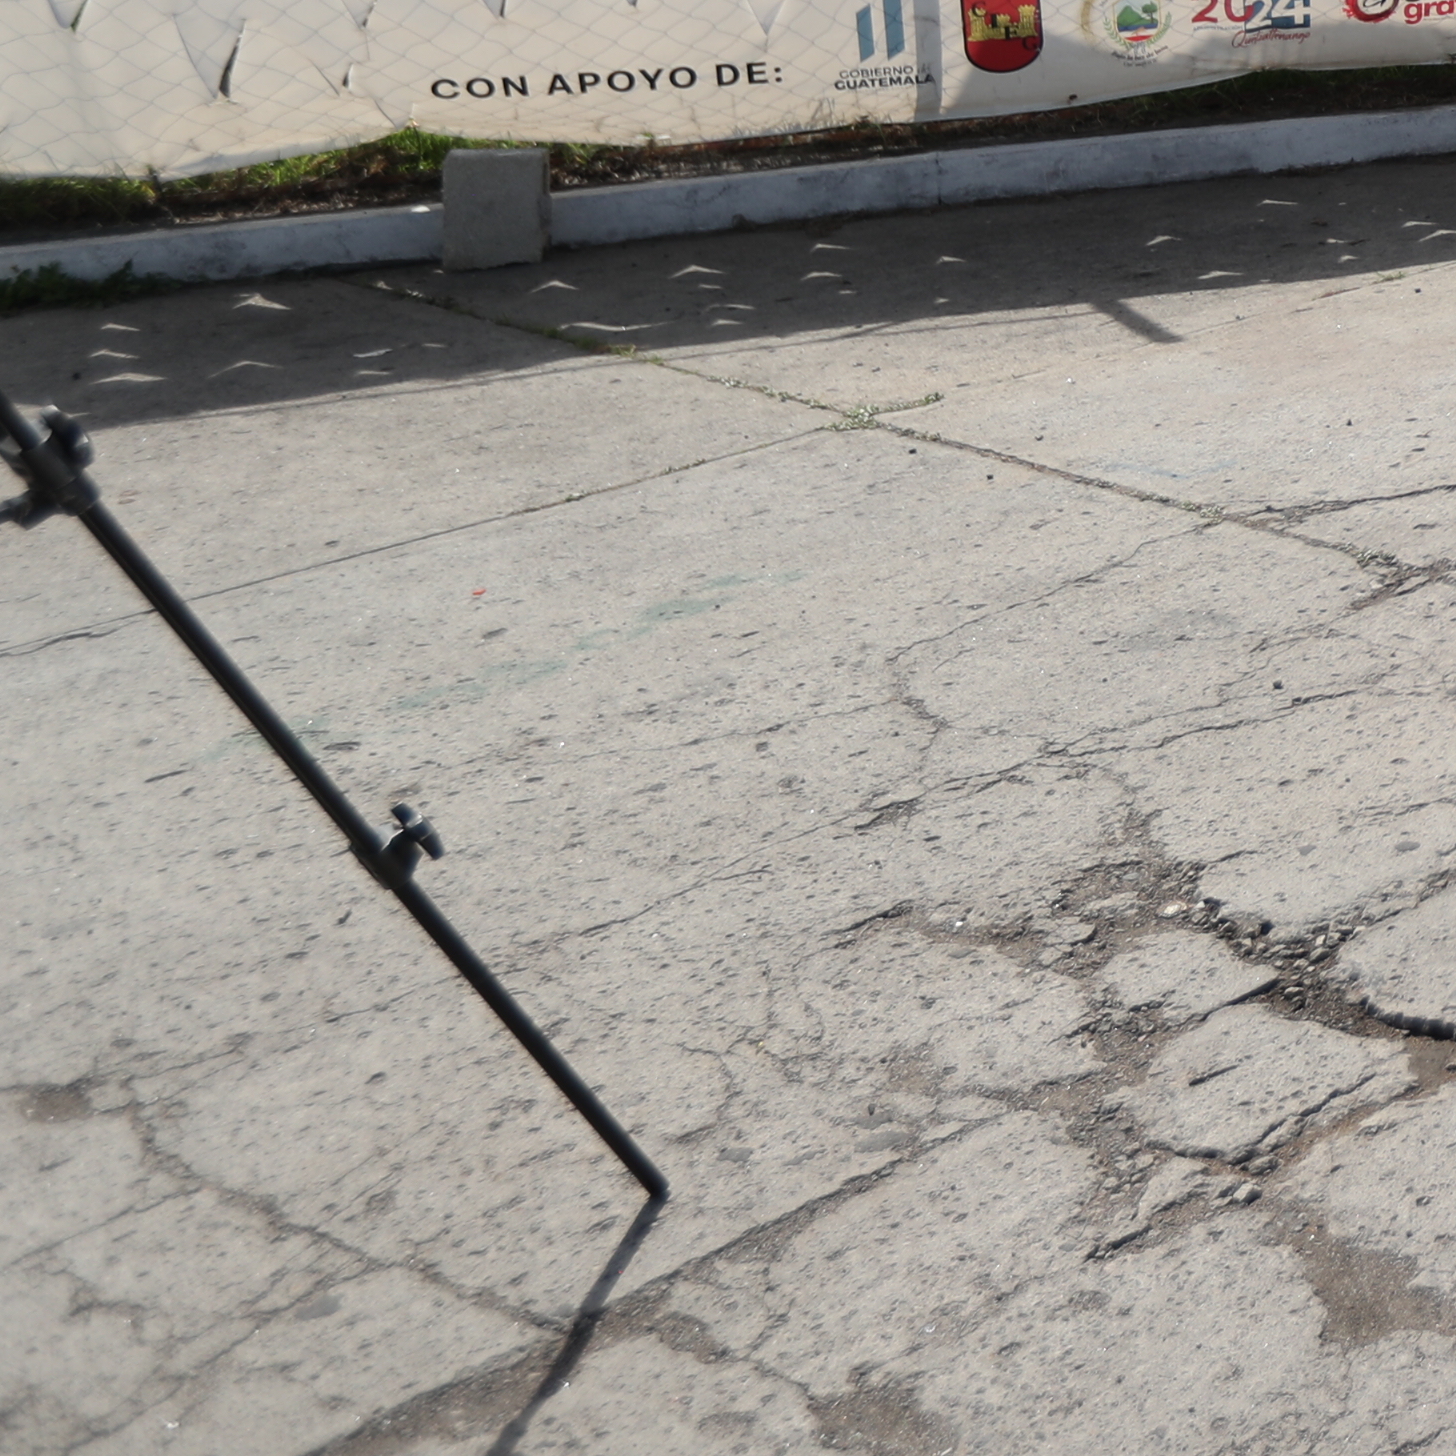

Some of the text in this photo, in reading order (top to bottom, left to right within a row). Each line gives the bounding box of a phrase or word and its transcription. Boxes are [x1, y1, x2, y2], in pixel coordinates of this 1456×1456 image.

[430, 61, 783, 100] CON APOYO DE:
[839, 65, 914, 79] GOBIERNO
[834, 73, 936, 91] GUATEMALA
